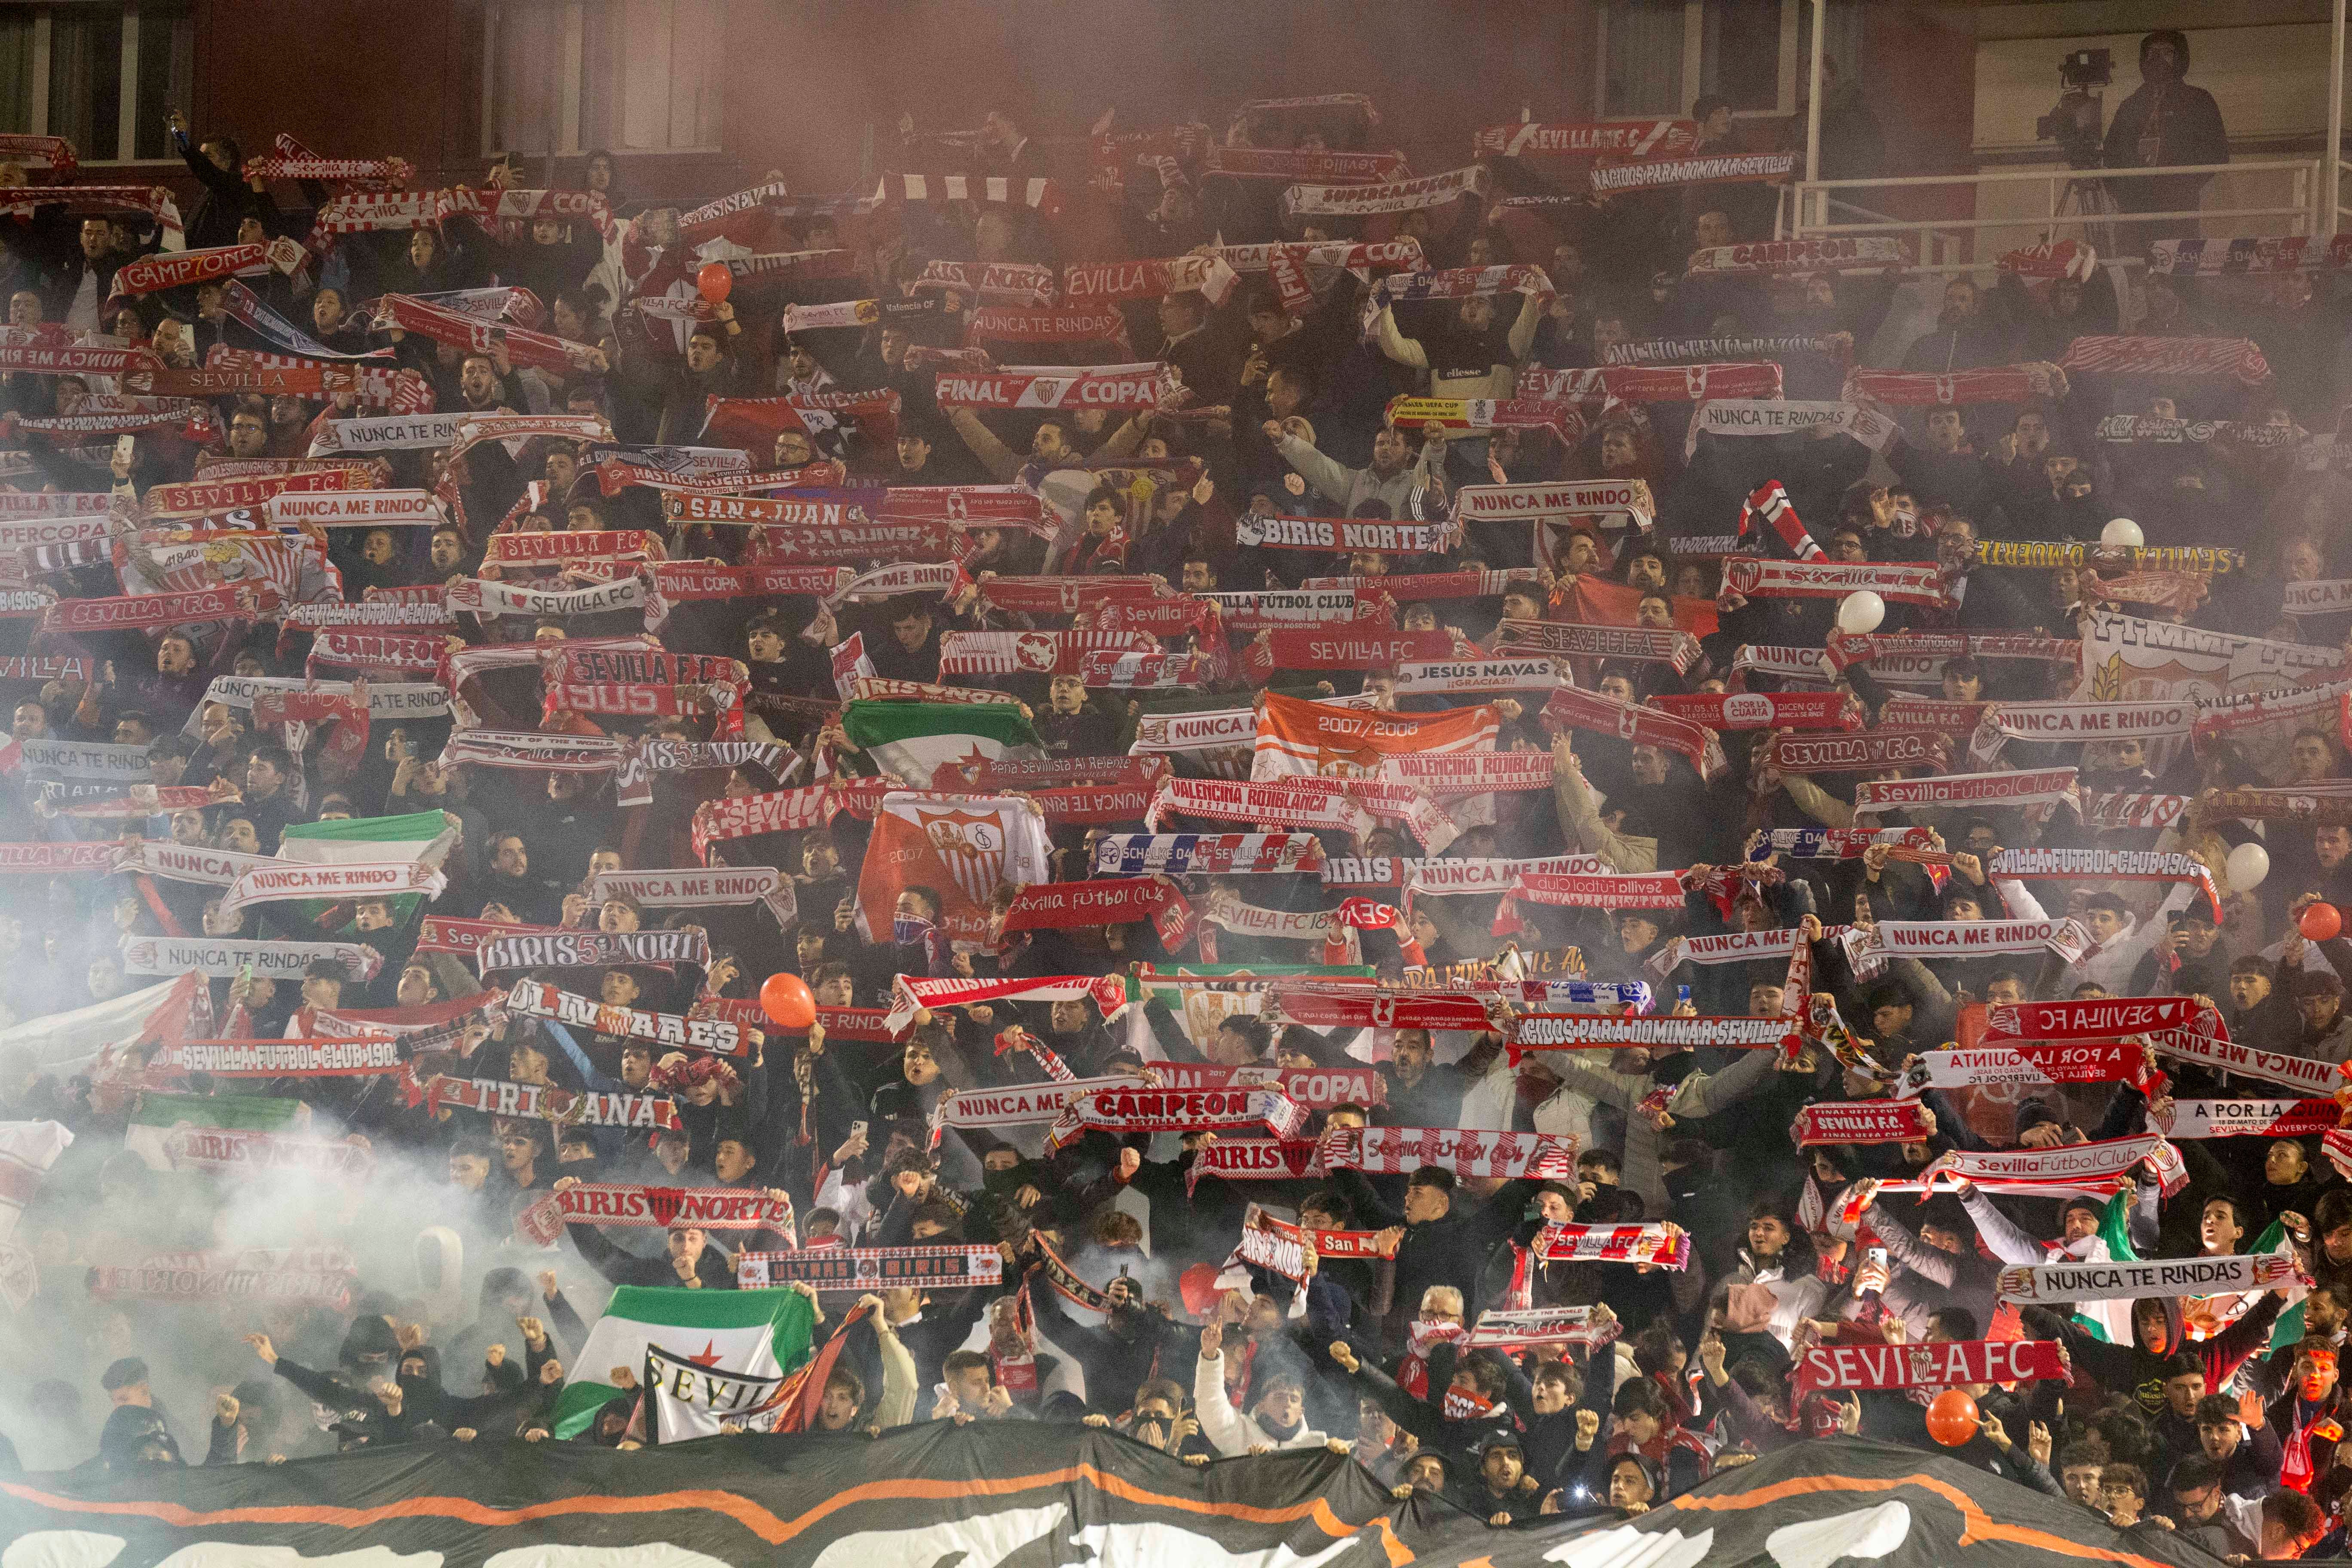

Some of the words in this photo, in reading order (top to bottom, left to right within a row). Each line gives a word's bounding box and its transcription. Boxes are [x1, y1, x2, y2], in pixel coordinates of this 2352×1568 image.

[1528, 131, 1600, 149] SEVILLA
[294, 162, 343, 173] Sevilla
[347, 162, 362, 172] FC
[1322, 171, 1462, 203] SUPERCAMPEON
[1591, 168, 1645, 191] NACIDOS
[1733, 239, 1858, 264] CAMPEON
[1418, 277, 1433, 286] 04
[886, 302, 922, 313] Valencia
[924, 300, 935, 309] CF
[190, 373, 286, 386] SEVILLA
[1446, 368, 1482, 378] ellesse
[937, 379, 1008, 403] FINAL
[1081, 381, 1155, 404] COPA
[1708, 409, 1763, 425] NUNCA
[1765, 411, 1784, 425] TE
[1788, 411, 1845, 425] RINDAS
[350, 429, 408, 444] NUNCA
[410, 426, 430, 440] TE
[580, 453, 594, 466] C.D.
[692, 456, 737, 469] SEVILLA
[176, 482, 289, 507] SEVILLA
[1472, 493, 1541, 511] NUNCA
[1546, 491, 1571, 508] ME
[1577, 490, 1632, 507] RINDO
[280, 500, 342, 517] NUNCA
[347, 500, 377, 514] ME
[377, 498, 429, 513] RINDO
[690, 498, 745, 520] SAN
[767, 504, 840, 526] JUAN
[508, 536, 600, 556] SEVILLA
[1263, 523, 1336, 547] BIRIS
[1342, 524, 1430, 550] NORTE
[1976, 540, 2066, 568] MUERTE
[2134, 545, 2233, 573] SEVILLA
[802, 575, 833, 591] REY
[882, 569, 909, 587] ME
[1789, 566, 1880, 586] Sevilla
[501, 591, 506, 606] I
[531, 593, 609, 615] SEVILLA
[611, 586, 634, 602] FC
[1258, 592, 1314, 609] FÚTBOL
[72, 601, 165, 623] SEVILLA
[1310, 642, 1384, 660] SEVILLA
[1388, 641, 1414, 660] FC
[1542, 627, 1656, 656] SEVILLA
[577, 652, 669, 685] SEVILLA
[1094, 663, 1143, 676] SEVILLA
[1419, 662, 1478, 680] JESÚS
[1483, 662, 1549, 677] NAVAS
[1732, 708, 1768, 717] CUARTA
[1778, 703, 1804, 711] DICEN
[1807, 702, 1825, 711] QUE
[1175, 718, 1245, 738] NUNCA
[2000, 713, 2076, 732] NUNCA
[2080, 711, 2110, 731] ME
[2117, 709, 2182, 729] RINDO
[468, 733, 482, 741] THE
[494, 735, 524, 743] BEST
[573, 738, 614, 747] WORLD
[21, 749, 78, 767] NUNCA
[82, 752, 102, 768] TE
[107, 753, 150, 769] RIND
[1780, 739, 1869, 765] SEVILLA
[1020, 758, 1071, 773] Sevillista
[1089, 756, 1131, 769] Relente
[1399, 757, 1479, 777] VALENCINA
[1420, 776, 1462, 785] HASTA
[1471, 775, 1487, 784] LA
[1171, 778, 1243, 804] VALENCINA
[1248, 789, 1329, 813] ROJIBLANCA
[1237, 804, 1252, 813] LA
[1805, 833, 1824, 844] 04
[1850, 833, 1906, 844] SEVILLA
[1121, 846, 1175, 859] SCHALKE
[1176, 848, 1192, 859] 04
[1215, 847, 1263, 859] SEVILLA
[158, 850, 234, 877] NUNCA
[252, 873, 313, 888] NUNCA
[317, 871, 342, 886] ME
[1423, 867, 1495, 885] NUNCA
[682, 878, 710, 895] ME
[715, 877, 772, 894] RINDO
[1010, 894, 1068, 916] Sevilla
[1282, 914, 1307, 929] FC
[1688, 933, 1758, 953] NUNCA
[1763, 930, 1790, 946] ME
[1893, 929, 1957, 946] NUNCA
[1964, 928, 1989, 945] ME
[1994, 924, 2052, 943] RINDO
[168, 948, 227, 967] NUNCA
[487, 935, 579, 967] BIRIS
[1631, 1018, 1712, 1046] DOMINAR
[181, 1044, 251, 1070] SEVILLA
[255, 1044, 315, 1069] FUTBOL
[321, 1043, 362, 1070] CLUB
[1289, 1073, 1371, 1103] COPA
[472, 1078, 658, 1128] TRIANA
[1036, 1093, 1064, 1110] ME
[1094, 1093, 1252, 1118] CAMPEON
[2195, 1103, 2208, 1118] A
[2215, 1103, 2254, 1118] POR
[2261, 1103, 2283, 1118] LA
[1125, 1117, 1184, 1126] SEVILLA
[1189, 1116, 1216, 1125] F.C.
[1818, 1117, 1874, 1130] SEVILLA
[2209, 1125, 2249, 1134] SEVILLA
[2275, 1123, 2331, 1133] LIVERPOOL
[557, 1190, 645, 1218] BIRIS
[683, 1198, 790, 1223] NORTE
[1324, 1235, 1354, 1252] San
[1559, 1233, 1613, 1247] SEVILLA
[774, 1261, 847, 1280] ULTRAS
[886, 1258, 959, 1276] BIRIS
[2045, 1269, 2123, 1291] NUNCA
[2126, 1268, 2154, 1286] TE
[2161, 1262, 2243, 1283] RINDAS
[1808, 1343, 1973, 1387] SEVILLA
[1984, 1340, 2035, 1380] FC
